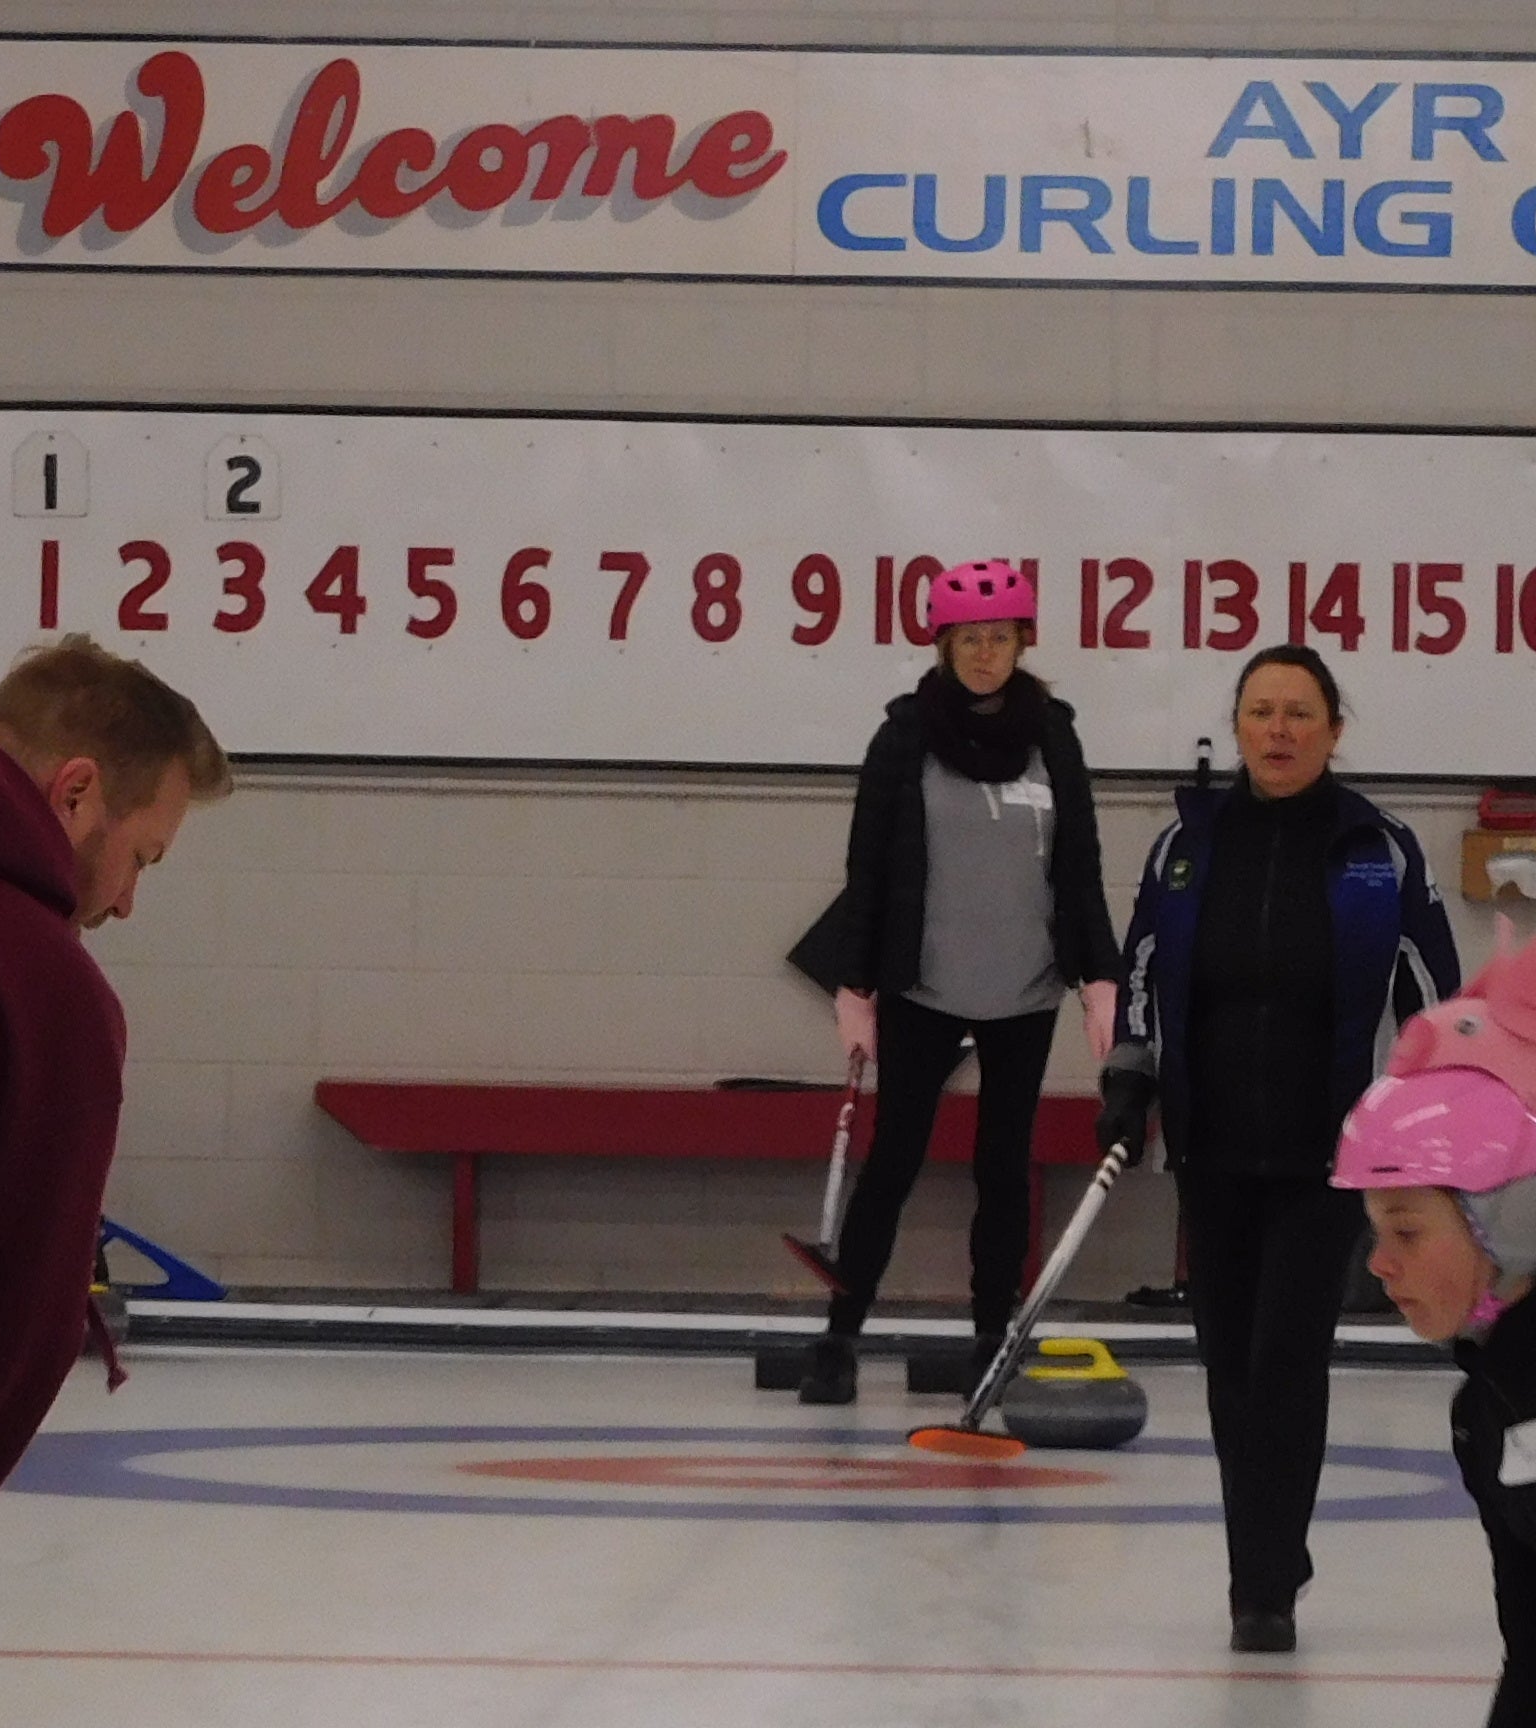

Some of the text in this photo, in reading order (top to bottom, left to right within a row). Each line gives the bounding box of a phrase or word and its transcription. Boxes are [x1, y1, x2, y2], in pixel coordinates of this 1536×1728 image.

[1212, 82, 1505, 161] AYR
[817, 173, 1454, 257] CURLING
[43, 453, 262, 515] 1 2
[40, 539, 60, 630] 1
[117, 539, 172, 631] 2
[213, 541, 267, 633] 3
[305, 545, 368, 635] 4
[406, 546, 459, 640] 5
[501, 547, 553, 641] 6
[599, 551, 652, 641] 7
[691, 552, 744, 643] 8
[792, 552, 843, 647] 9
[875, 554, 946, 646] 10
[1080, 557, 1154, 650] 12
[1183, 559, 1261, 652] 13
[1288, 561, 1366, 652] 14
[1392, 562, 1468, 656] 15
